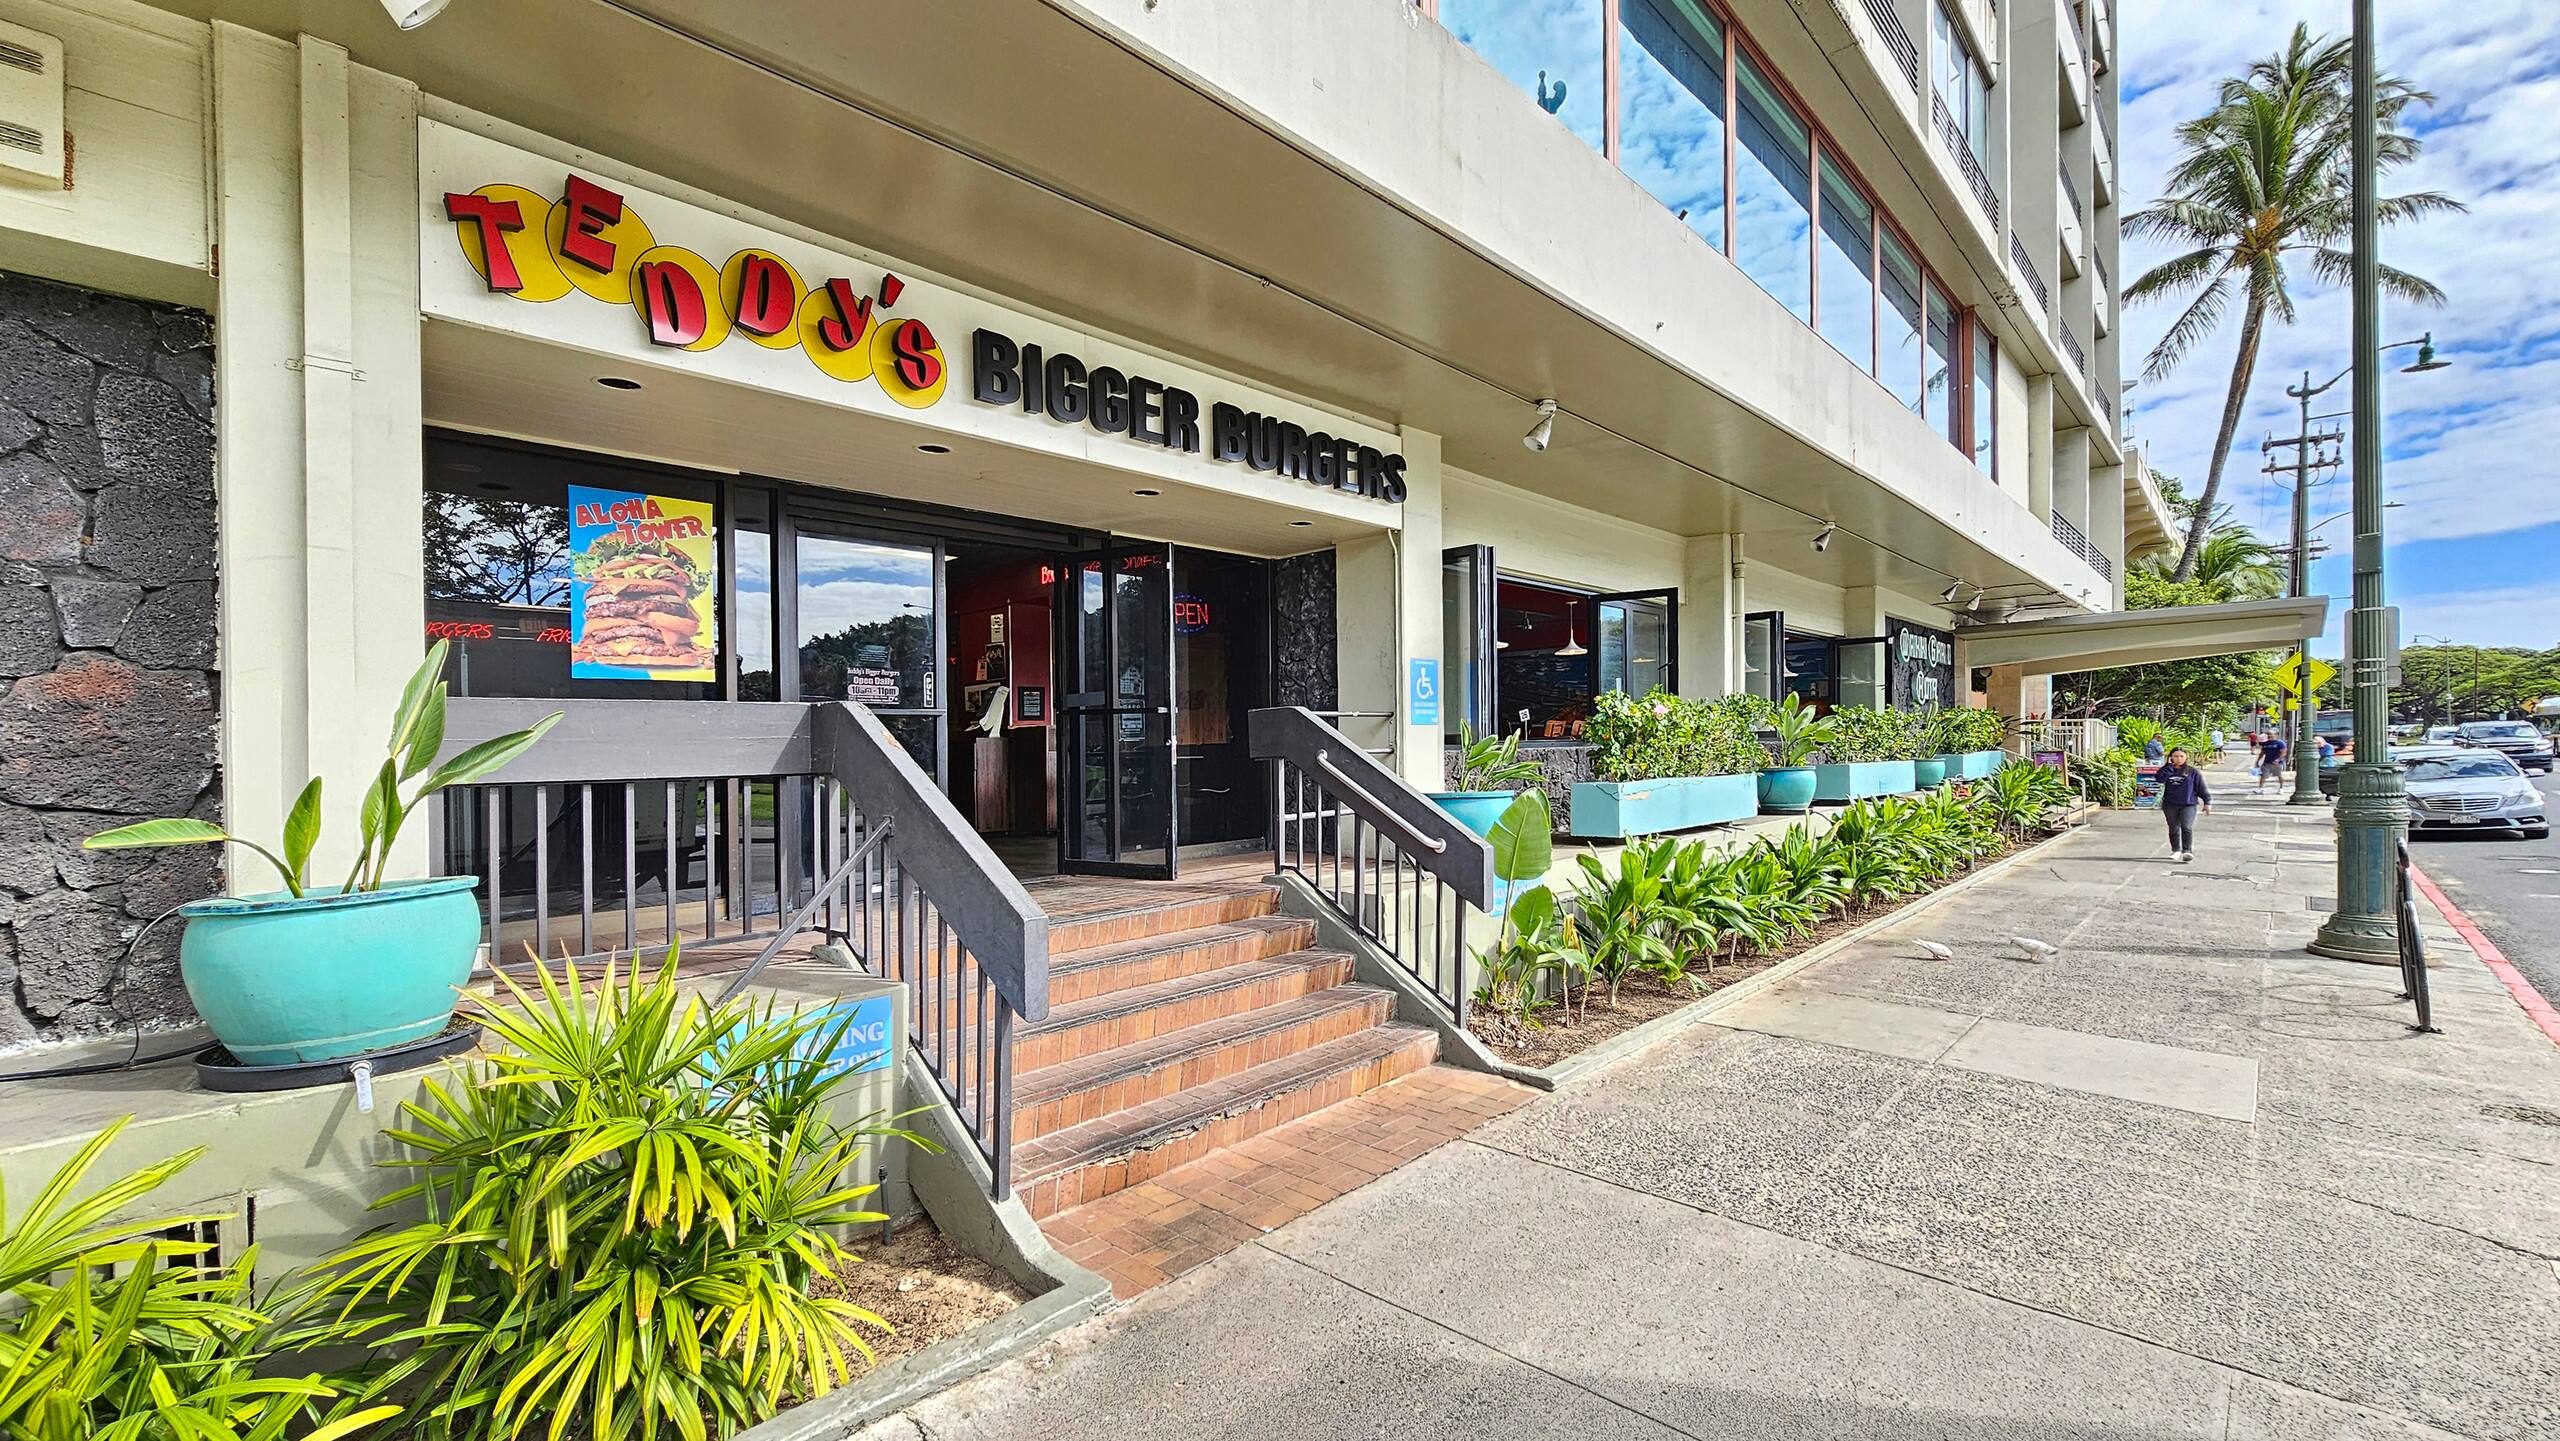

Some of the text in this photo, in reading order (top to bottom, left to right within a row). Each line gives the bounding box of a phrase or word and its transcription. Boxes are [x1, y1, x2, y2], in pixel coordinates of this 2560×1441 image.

[972, 327, 1200, 453] BIGGER
[1212, 400, 1408, 504] BURGERS
[576, 498, 664, 527] ALOHA
[616, 515, 708, 545] TOWER
[1175, 603, 1208, 625] PEN
[425, 621, 572, 643] RGERS FRI
[853, 676, 895, 686] Open Daily
[878, 687, 896, 695] 11pm
